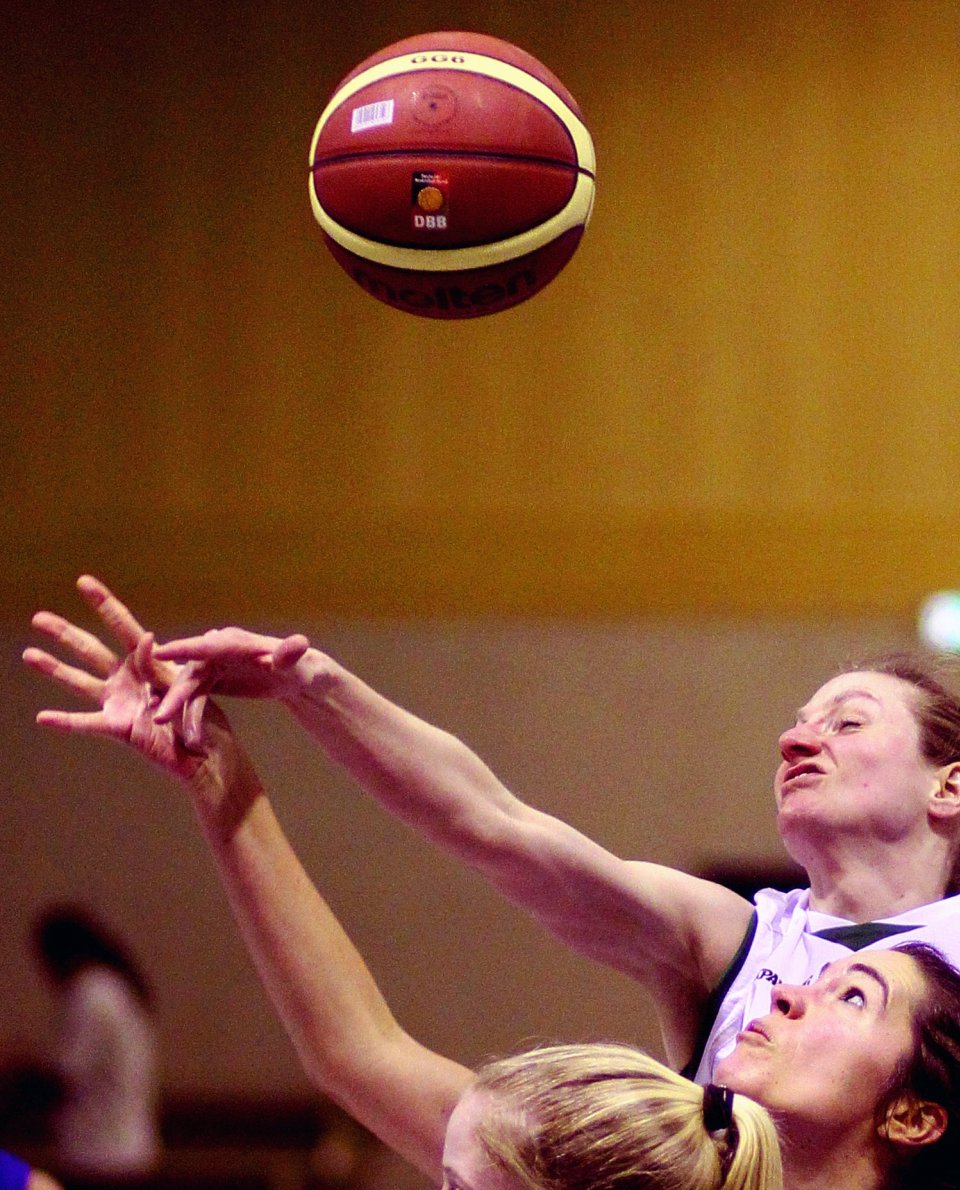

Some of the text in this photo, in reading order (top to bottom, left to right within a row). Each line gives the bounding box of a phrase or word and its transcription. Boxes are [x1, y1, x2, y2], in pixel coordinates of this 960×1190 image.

[411, 54, 465, 64] GG6
[414, 215, 448, 229] DBB
[353, 269, 536, 310] molten
